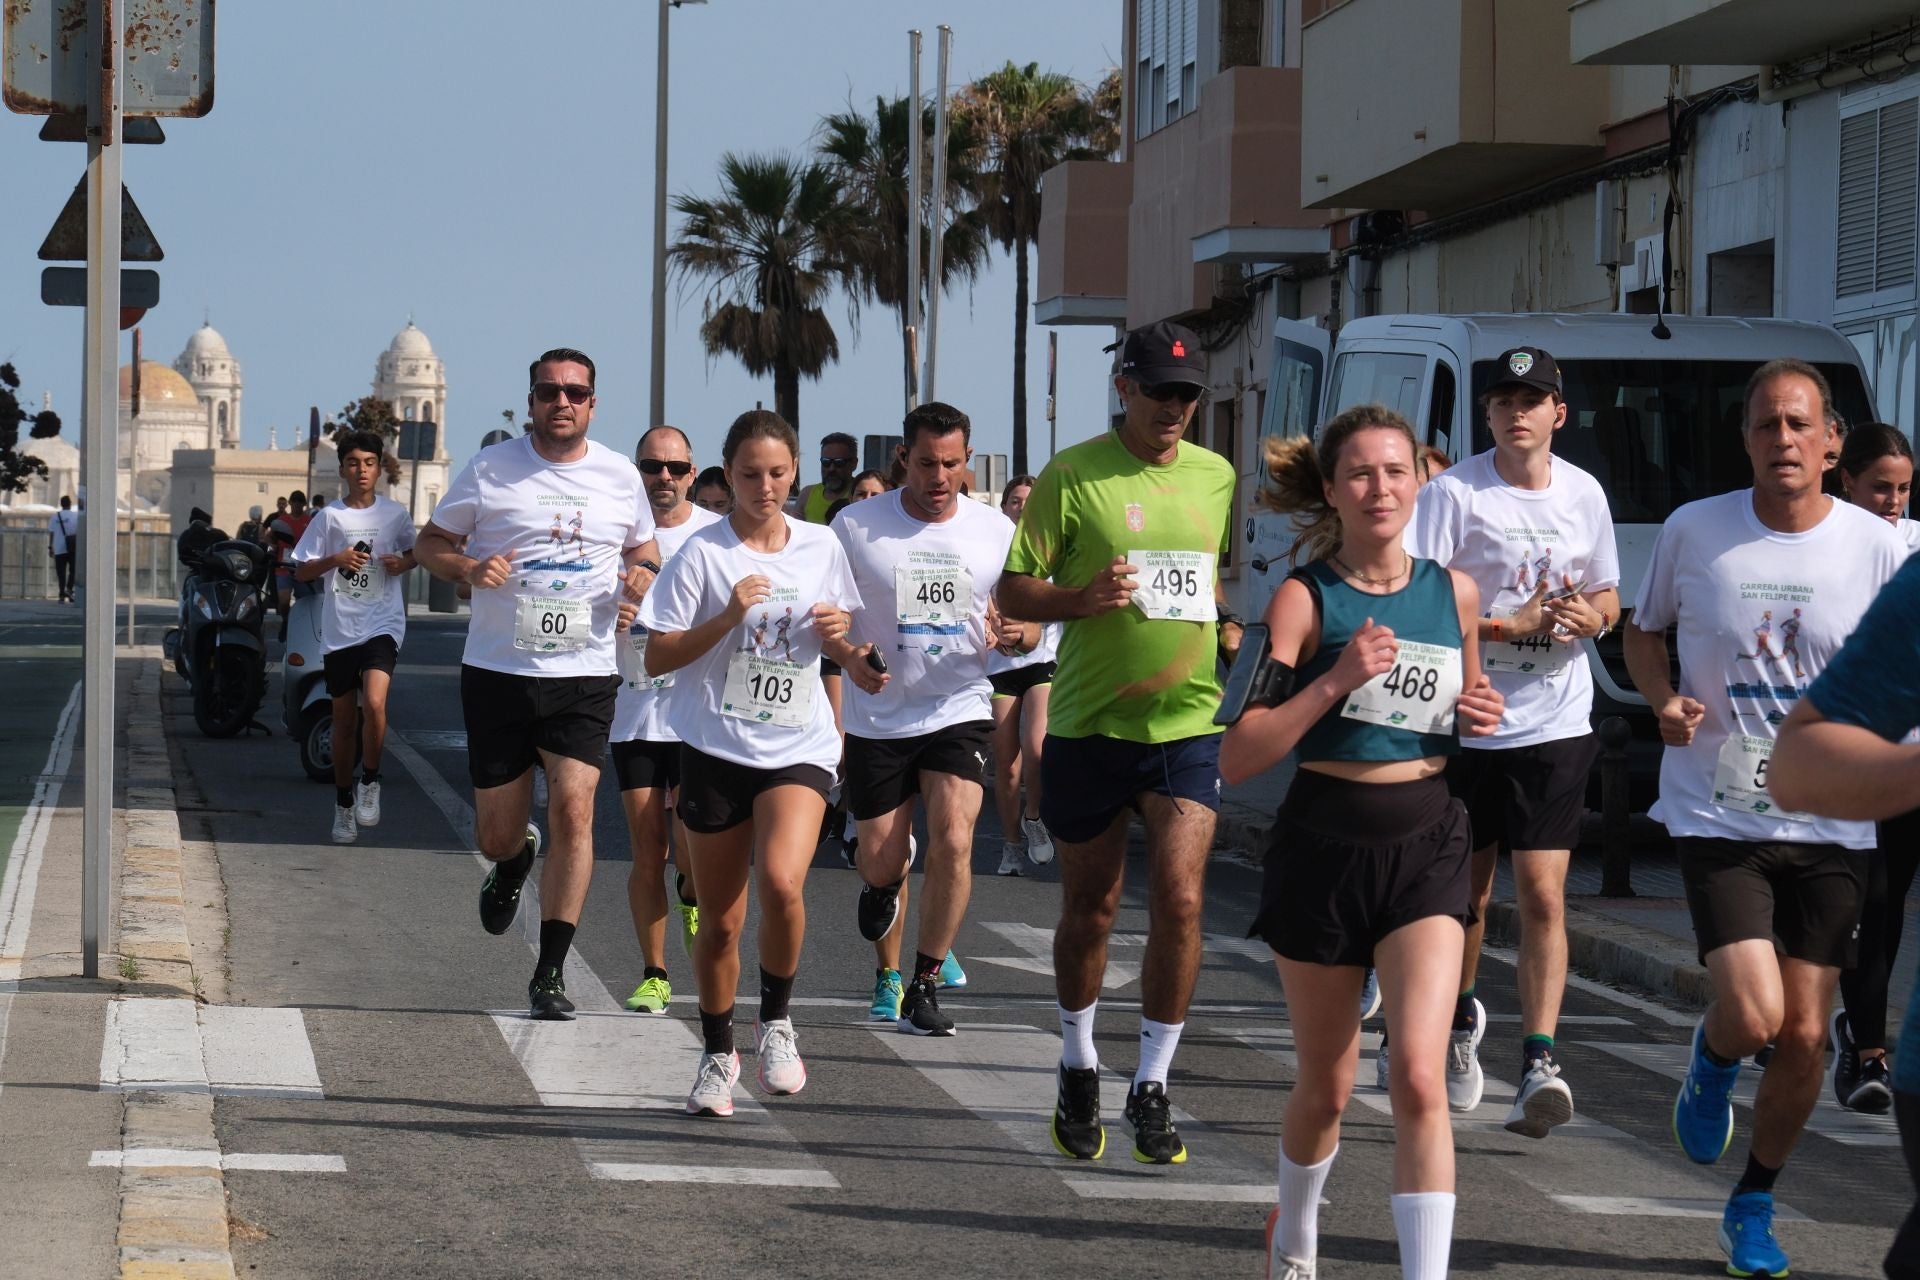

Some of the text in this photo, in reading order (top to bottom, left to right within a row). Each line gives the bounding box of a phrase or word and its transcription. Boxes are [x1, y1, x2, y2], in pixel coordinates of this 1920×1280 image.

[1504, 527, 1559, 536] CARRERA URBANA
[1506, 534, 1557, 543] SAN FELIPE NERI
[907, 550, 961, 560] CARRERA URBANA
[1145, 551, 1202, 560] CARRERA URBANA
[1146, 559, 1200, 568] SAN FELIPE NERI
[910, 567, 959, 576] CARRERA URBANA
[351, 573, 369, 588] 98
[1151, 568, 1198, 597] 495
[771, 587, 799, 595] URBANA
[916, 581, 955, 605] 466
[1740, 582, 1814, 594] CARRERA URBANA
[531, 596, 558, 604] CARRERA
[781, 594, 798, 602] NERI
[1741, 591, 1811, 603] SAN FELIPE NERI
[544, 604, 564, 612] FELIPE
[541, 612, 567, 634] 60
[1397, 642, 1447, 656] RERA URBANA
[748, 656, 804, 670] CARRERA URBANA
[1400, 654, 1446, 666] FELIPE NERI
[762, 665, 784, 675] FELIPE
[785, 669, 801, 677] NERI
[750, 673, 793, 704] 103
[1382, 663, 1439, 703] 468
[1741, 735, 1773, 747] CARRER
[1742, 745, 1773, 757] SAN FEL
[1753, 759, 1769, 789] 5
